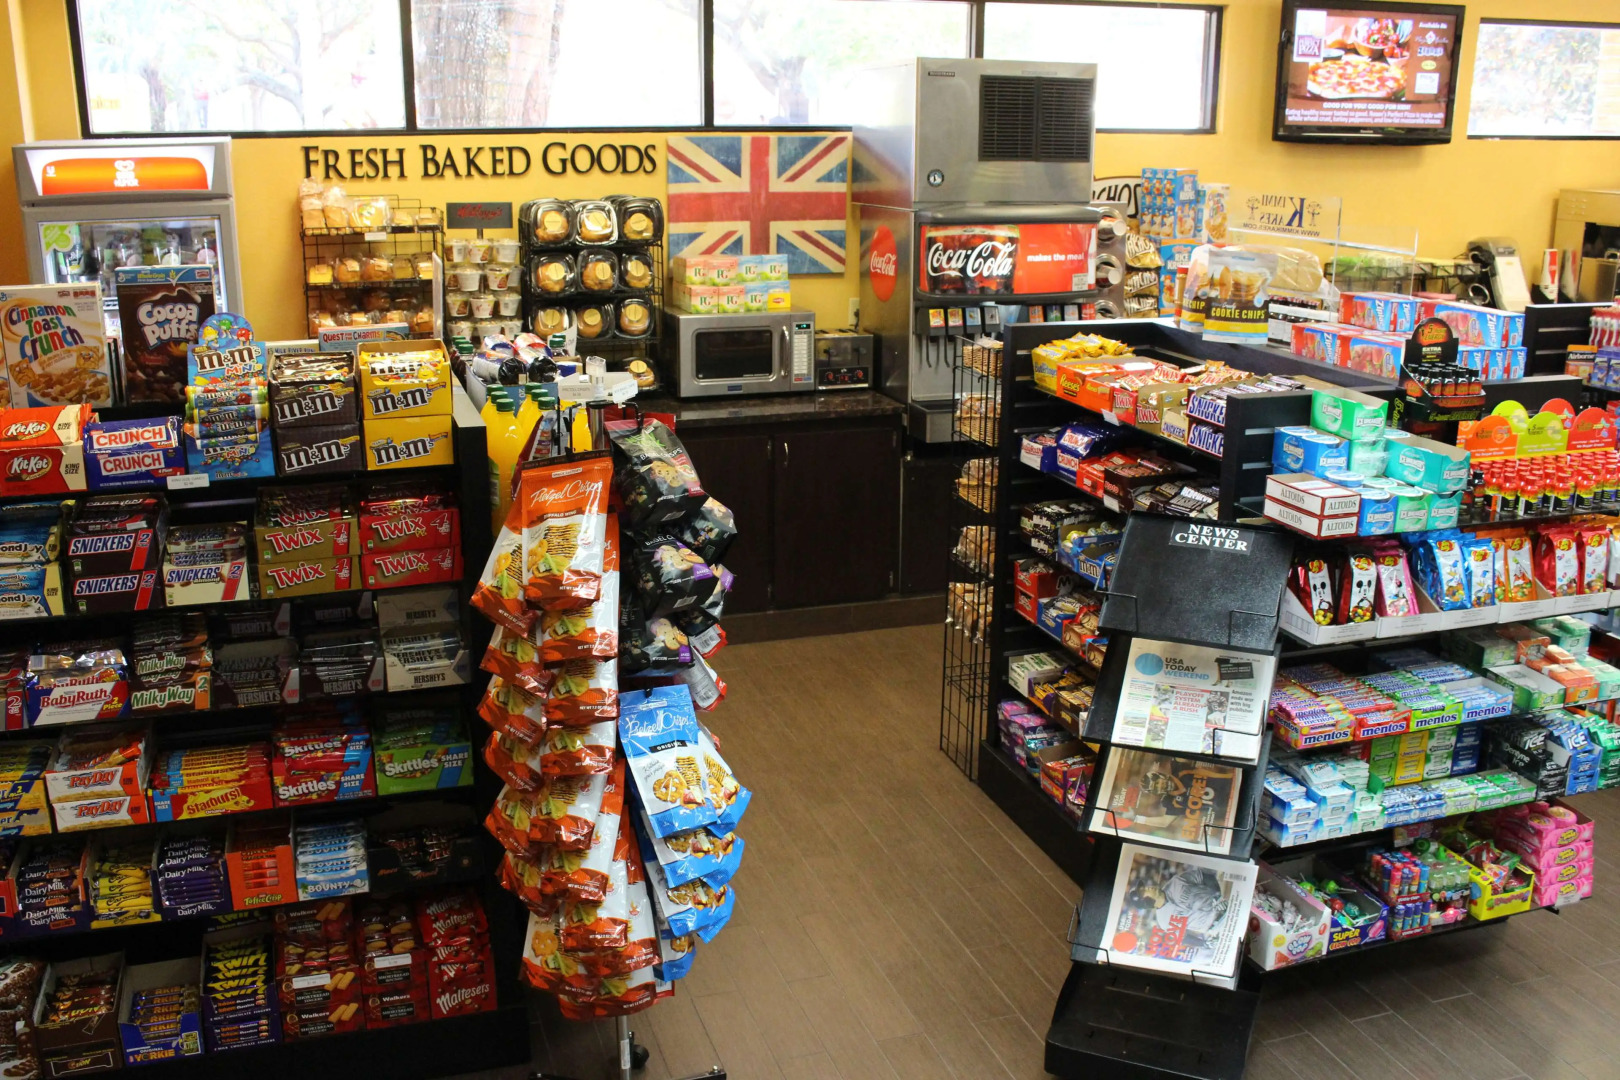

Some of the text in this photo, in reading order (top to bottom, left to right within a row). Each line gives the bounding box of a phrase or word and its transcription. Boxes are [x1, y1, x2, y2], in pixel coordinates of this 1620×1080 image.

[300, 141, 658, 182] FRESH BAKED GOODS
[927, 240, 1017, 278] Coca-Cola
[1027, 252, 1084, 263] makes the meal
[8, 305, 76, 327] Cinnamon
[138, 303, 198, 326] Cocoa
[1211, 308, 1265, 319] COOKIE CHIPS
[27, 316, 65, 338] Toast
[143, 319, 199, 347] Puffs
[1428, 324, 1434, 333] 5
[1486, 314, 1496, 346] Ziploc
[19, 326, 85, 361] Crunch
[1324, 333, 1332, 360] Ziploc
[195, 346, 261, 372] m&m's
[275, 391, 344, 421] m&m's
[370, 388, 432, 415] m&m's
[1189, 395, 1226, 424] SNICKE
[1137, 404, 1160, 424] Twix
[95, 426, 164, 447] CRUNCH
[1163, 422, 1185, 437] SNICKERS
[282, 439, 350, 470] m&m's
[373, 437, 434, 466] m&m's
[102, 454, 162, 473] CRUNCH
[1058, 452, 1079, 469] CRUNCH
[531, 480, 603, 507] Pretzel Crisps
[1280, 487, 1305, 505] ALTOIDS
[1328, 497, 1357, 510] ALTOIDS
[1278, 508, 1303, 526] ALTOIDS
[328, 524, 345, 537] 4
[1188, 524, 1240, 539] NEWS
[1325, 520, 1354, 532] ALTOIDS
[71, 533, 150, 553] SNICKERS 2
[1175, 533, 1248, 551] CENTER
[331, 558, 348, 572] 4
[167, 565, 241, 583] SNICKERS 2
[76, 574, 153, 594] SNICKERS 2
[406, 609, 436, 619] HERSHEY'S
[1165, 657, 1184, 665] USA
[1165, 663, 1197, 672] TODAY
[198, 675, 207, 689] 2
[414, 673, 446, 684] HERSHEY'S
[1164, 670, 1210, 680] WEEKEND
[323, 679, 363, 692] HERSHEY'S
[1175, 690, 1205, 698] PLAYOFF
[103, 702, 123, 711] Piece
[1174, 701, 1205, 709] ALREADY
[1466, 705, 1507, 719] mentos
[626, 712, 689, 740] Pretzel Crisps
[1275, 714, 1299, 733] mentos
[1416, 713, 1457, 728] mentos
[1304, 730, 1349, 744] mentos
[1361, 722, 1406, 737] mentos
[1524, 732, 1547, 750] ICE
[1568, 732, 1588, 750] ICE
[441, 753, 468, 762] SHARE
[444, 760, 463, 768] SIZE
[384, 757, 439, 777] Skittles
[340, 773, 365, 782] SHARE
[344, 780, 360, 788] SIZE
[278, 780, 336, 800] Skittles
[1119, 788, 1127, 805] TODAY
[186, 788, 242, 816] Starburst
[1112, 795, 1120, 805] USA
[165, 856, 187, 866] Dairy
[164, 870, 187, 878] Dairy
[25, 887, 47, 897] Dairy
[307, 882, 350, 893] BOUNTY
[177, 906, 197, 916] Dairy
[289, 908, 317, 917] Walkers
[30, 917, 50, 926] Dairy
[1124, 911, 1133, 931] TODAY
[1146, 925, 1165, 955] HOT
[1160, 914, 1181, 958] STOVE
[1333, 929, 1360, 942] SUPER
[382, 993, 410, 1002] Walkers
[436, 983, 490, 1014] Maltesers
[301, 1011, 330, 1019] Walkers
